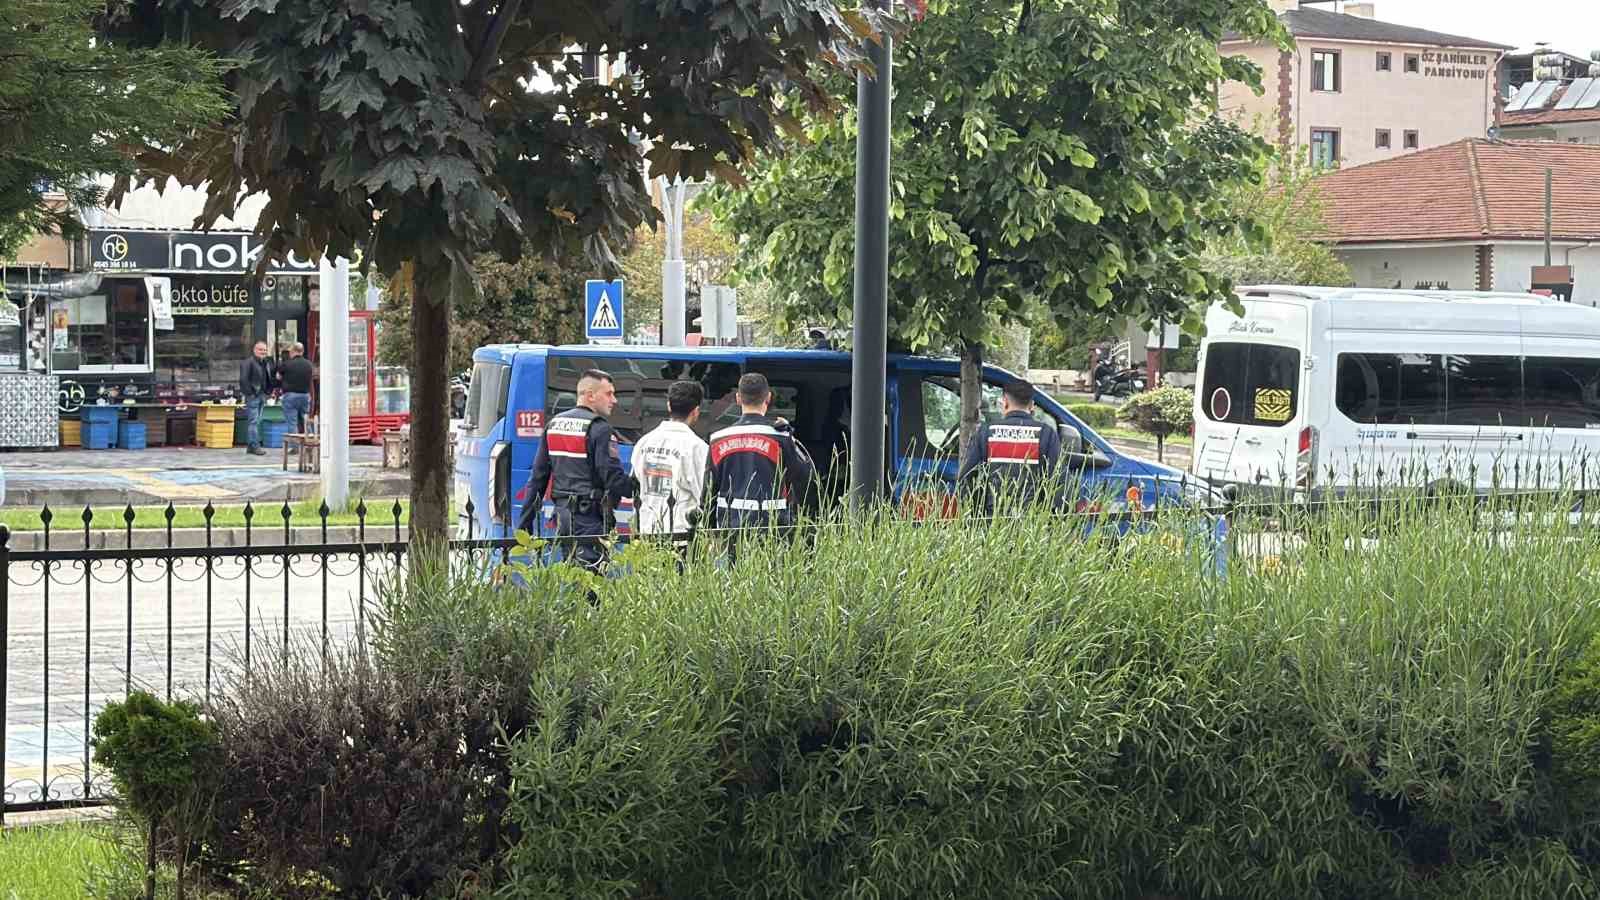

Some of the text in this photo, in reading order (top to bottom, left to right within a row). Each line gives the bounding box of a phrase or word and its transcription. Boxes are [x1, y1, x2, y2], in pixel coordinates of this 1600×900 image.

[1425, 66, 1485, 79] PANSİYONU
[175, 235, 316, 268] noka
[171, 284, 248, 303] okta büfe
[520, 412, 540, 427] 112
